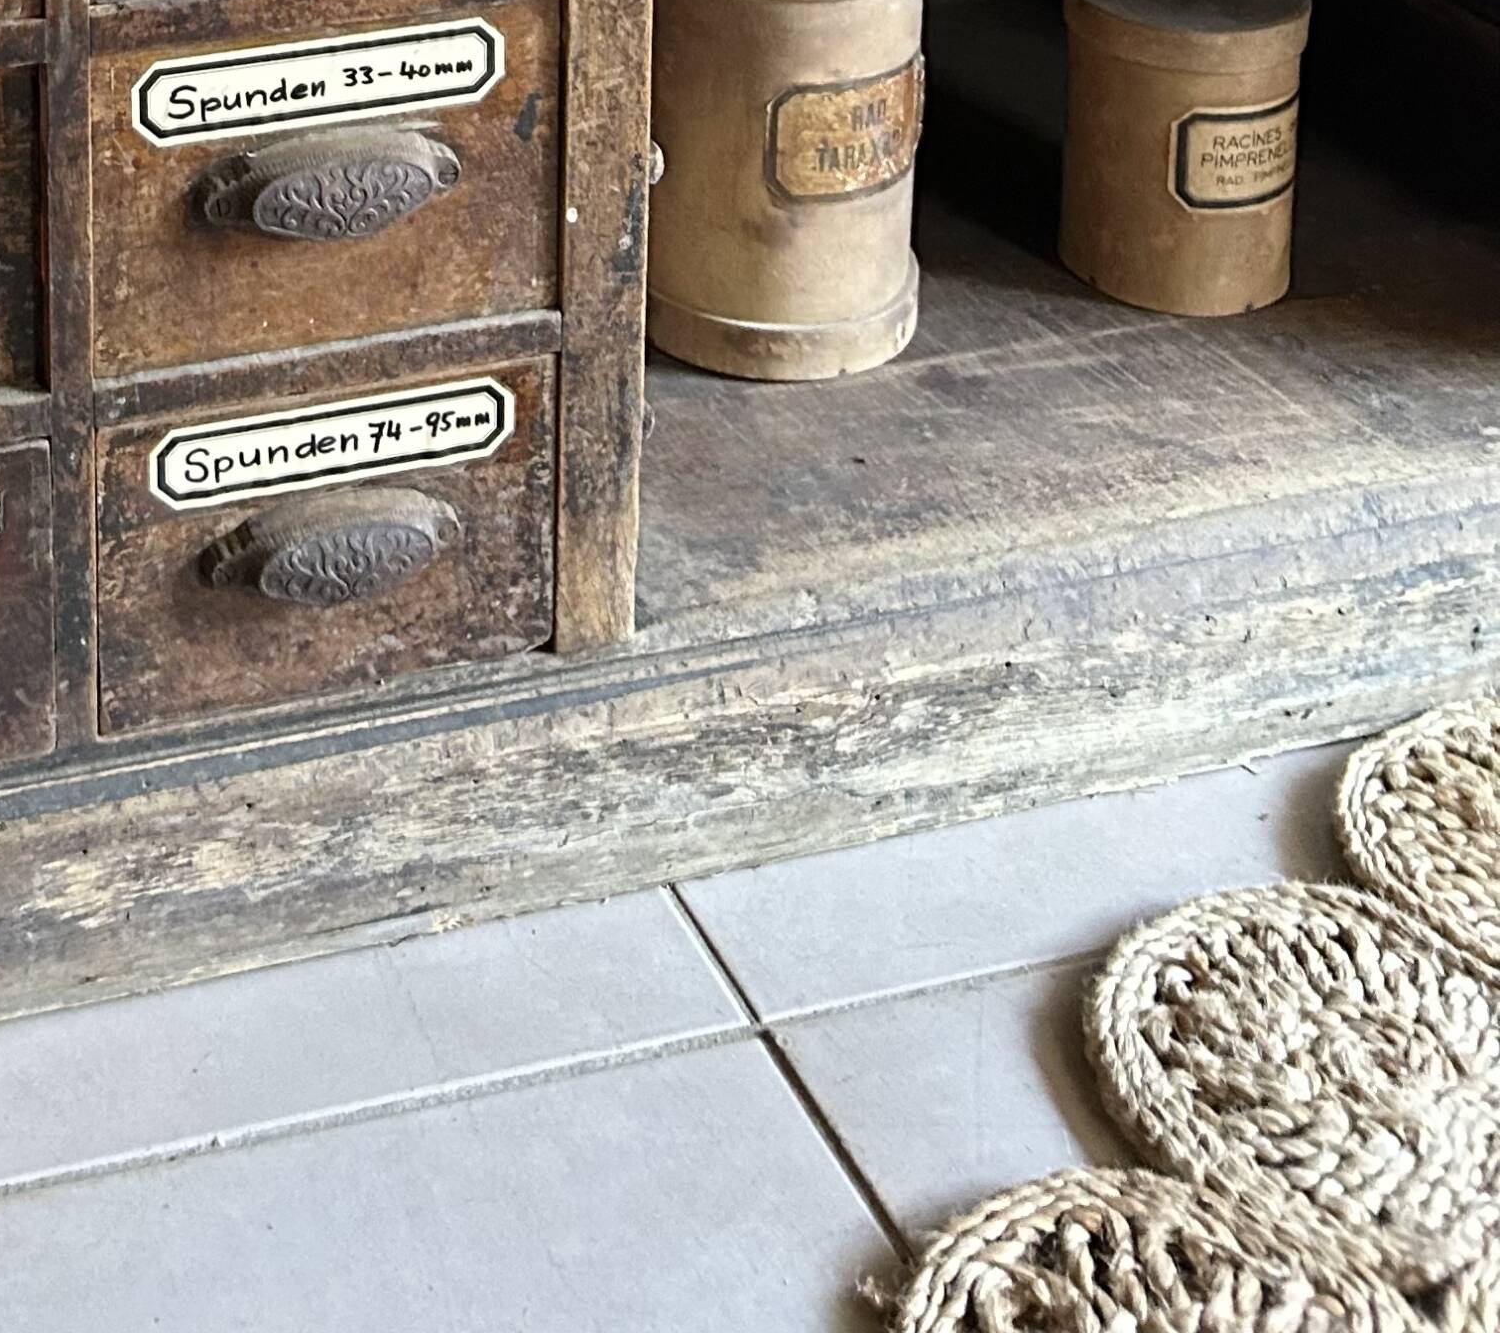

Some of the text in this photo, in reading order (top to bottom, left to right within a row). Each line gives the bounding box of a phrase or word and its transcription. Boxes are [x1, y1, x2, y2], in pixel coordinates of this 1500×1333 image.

[167, 77, 326, 122] Spunden
[1212, 125, 1283, 151] RACINES
[184, 432, 359, 484] Spunden
